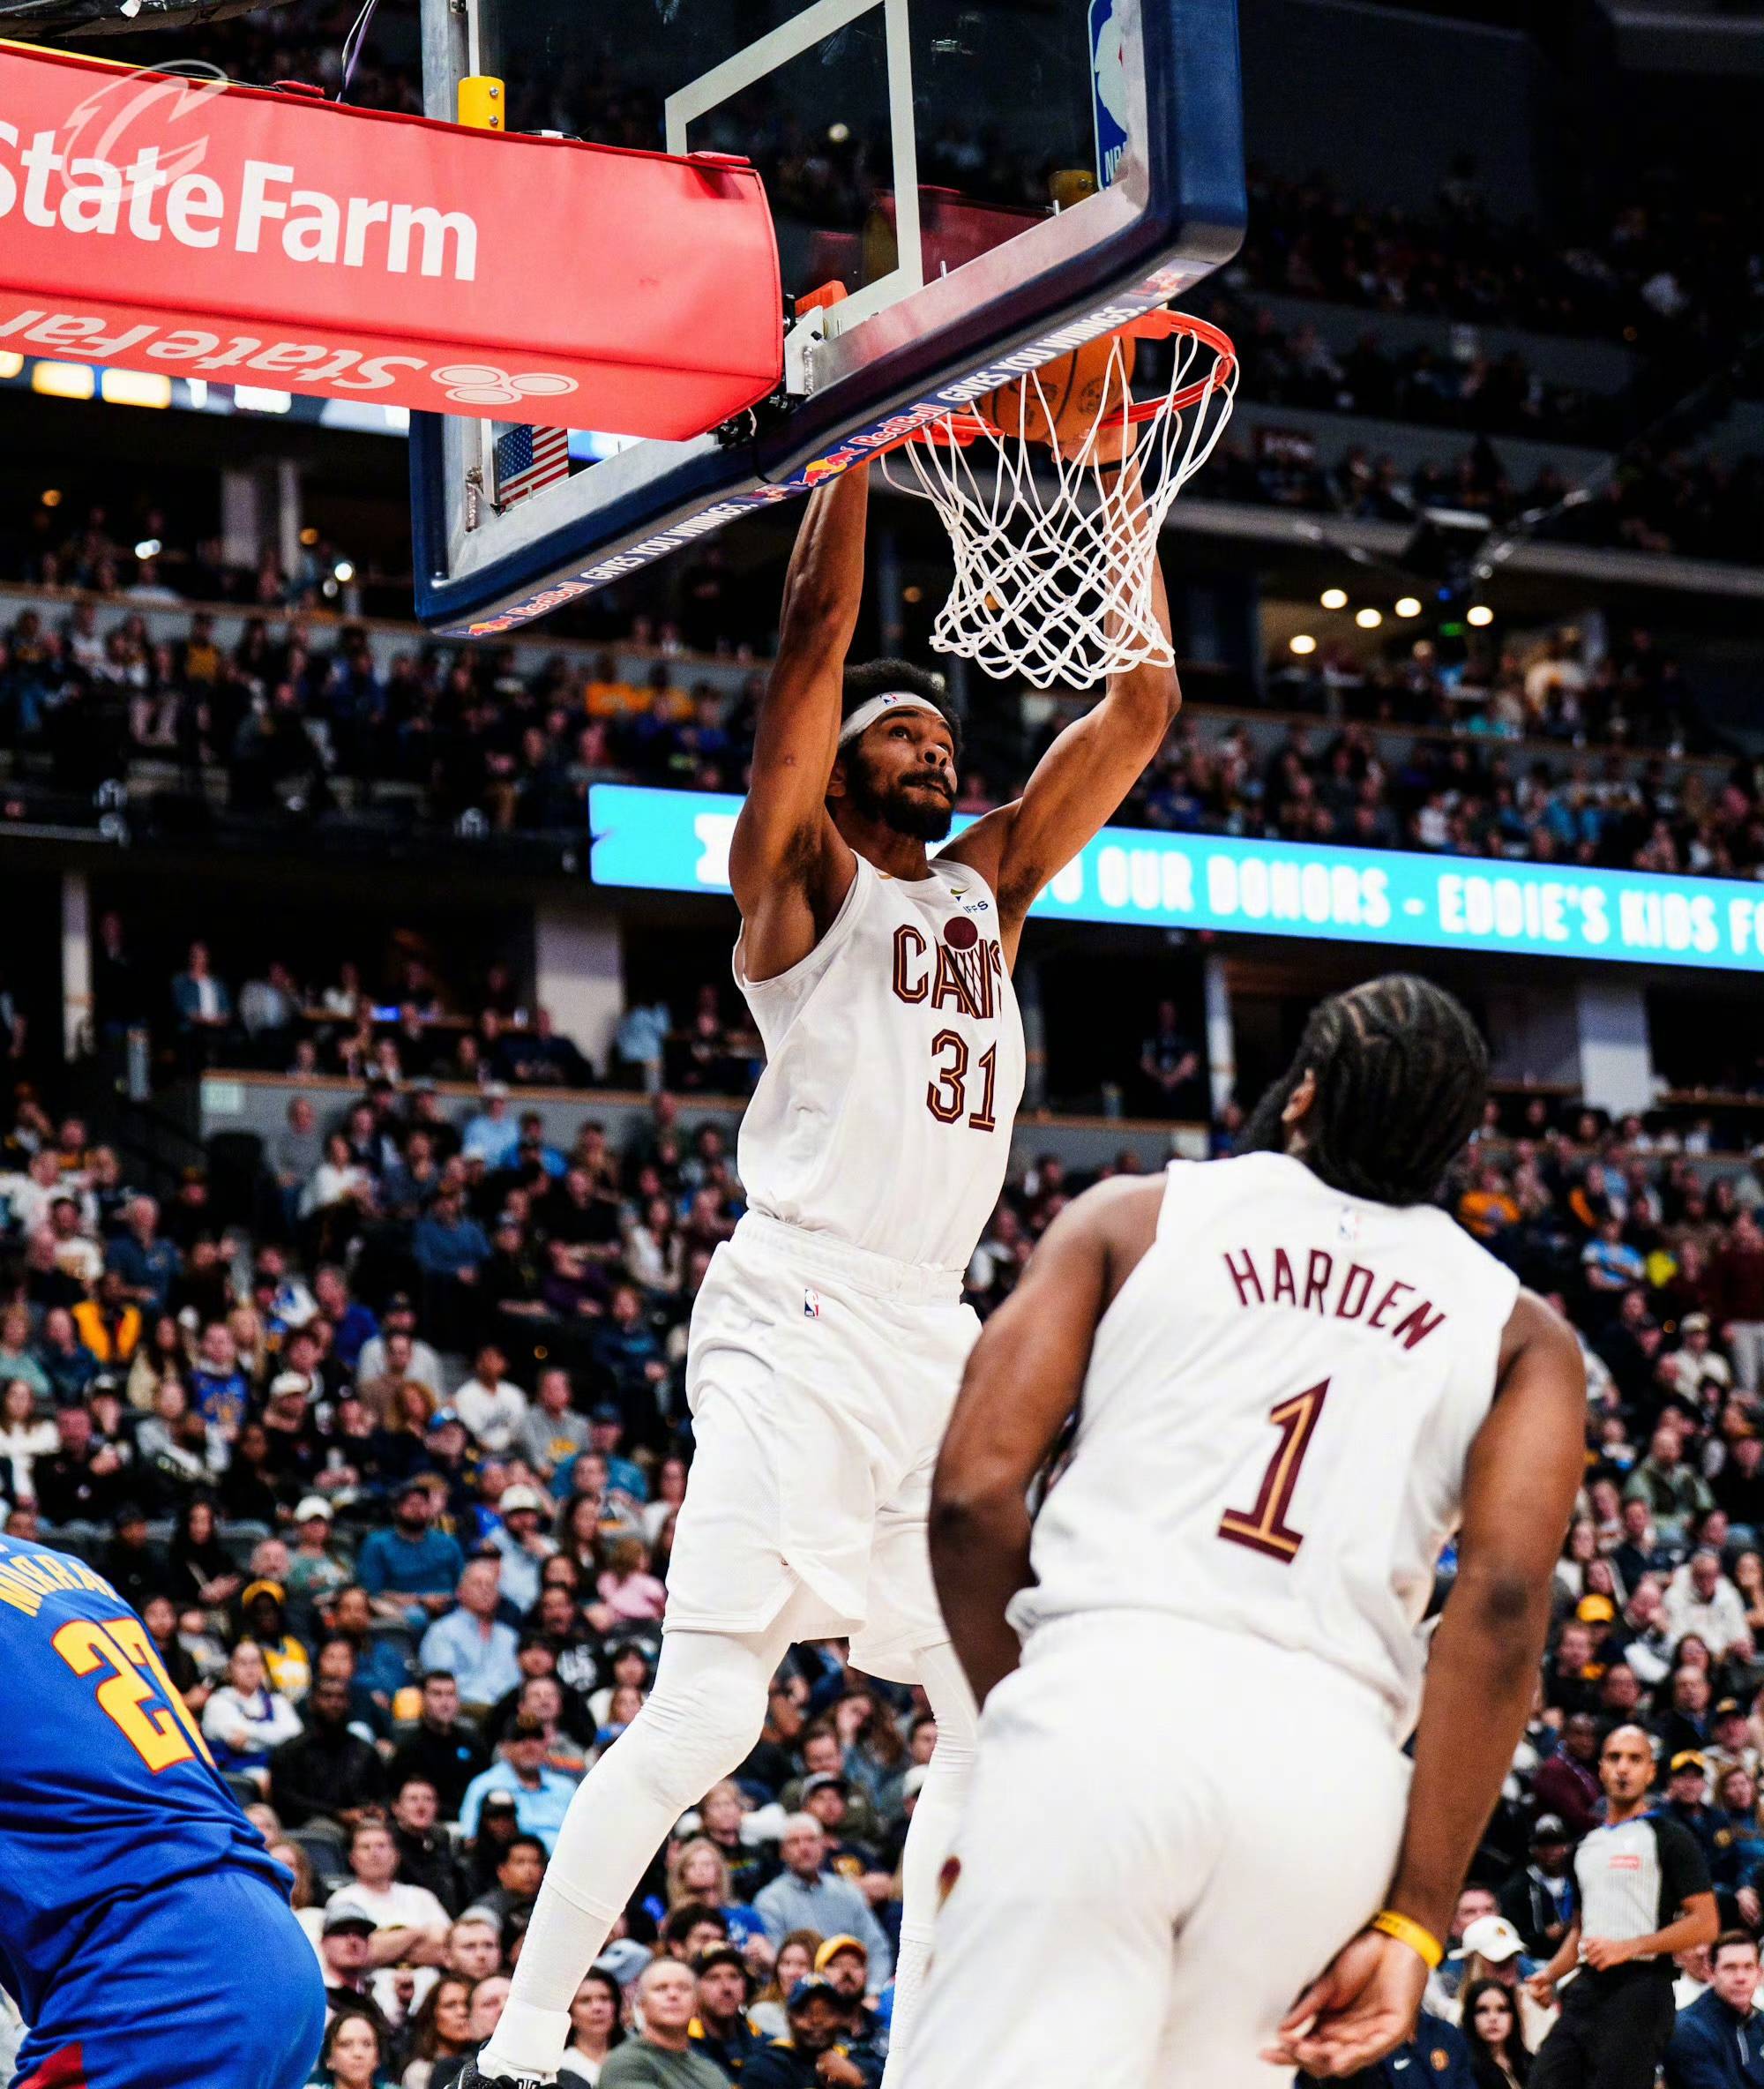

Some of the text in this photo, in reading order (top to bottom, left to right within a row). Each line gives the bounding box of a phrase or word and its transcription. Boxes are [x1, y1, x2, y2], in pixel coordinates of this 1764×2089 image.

[235, 160, 478, 281] Farm
[146, 330, 428, 390] State
[937, 371, 1012, 402] GIVES
[990, 348, 1057, 372] YOU
[579, 556, 646, 580] GIVES
[631, 536, 684, 557] YOU
[1097, 844, 1194, 912] OUR
[1207, 854, 1392, 928] DONORS
[1438, 872, 1611, 945] EDDIE'S
[1619, 888, 1719, 953] KIDS
[926, 1028, 997, 1133] 31
[1223, 1247, 1447, 1351] HARDEN
[1216, 1375, 1333, 1565] 1
